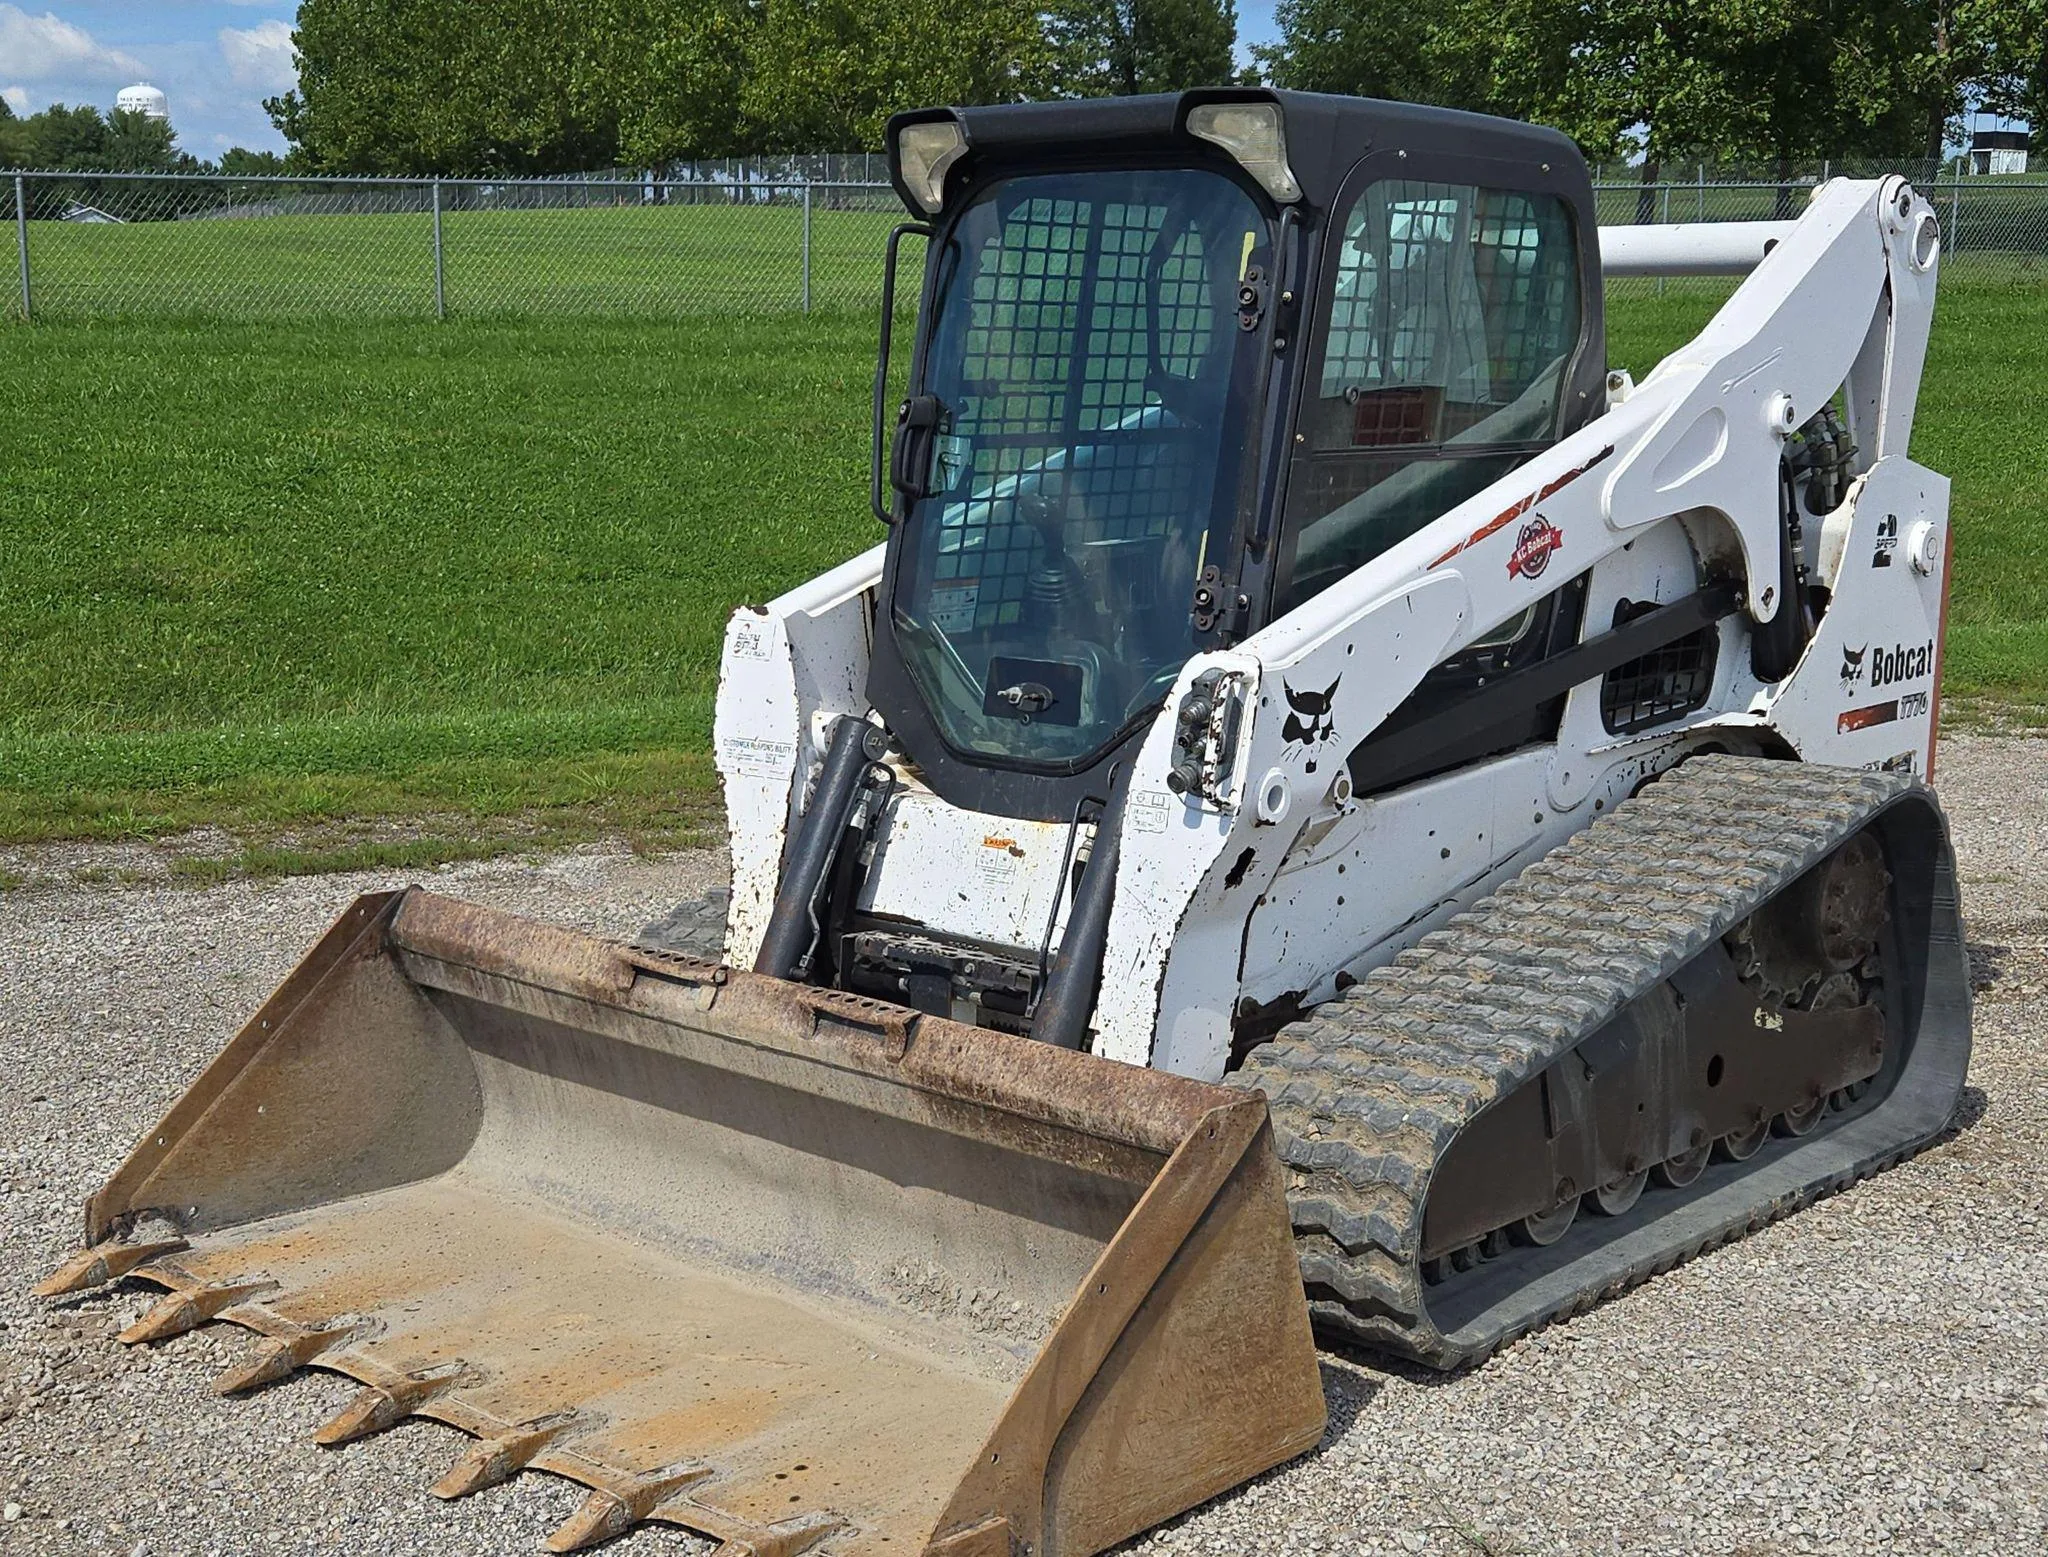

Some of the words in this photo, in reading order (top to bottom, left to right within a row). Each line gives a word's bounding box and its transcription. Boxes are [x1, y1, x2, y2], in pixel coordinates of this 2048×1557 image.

[1527, 531, 1552, 554] Bobcat
[1871, 638, 1933, 688] Bobcat
[1900, 690, 1928, 719] T770
